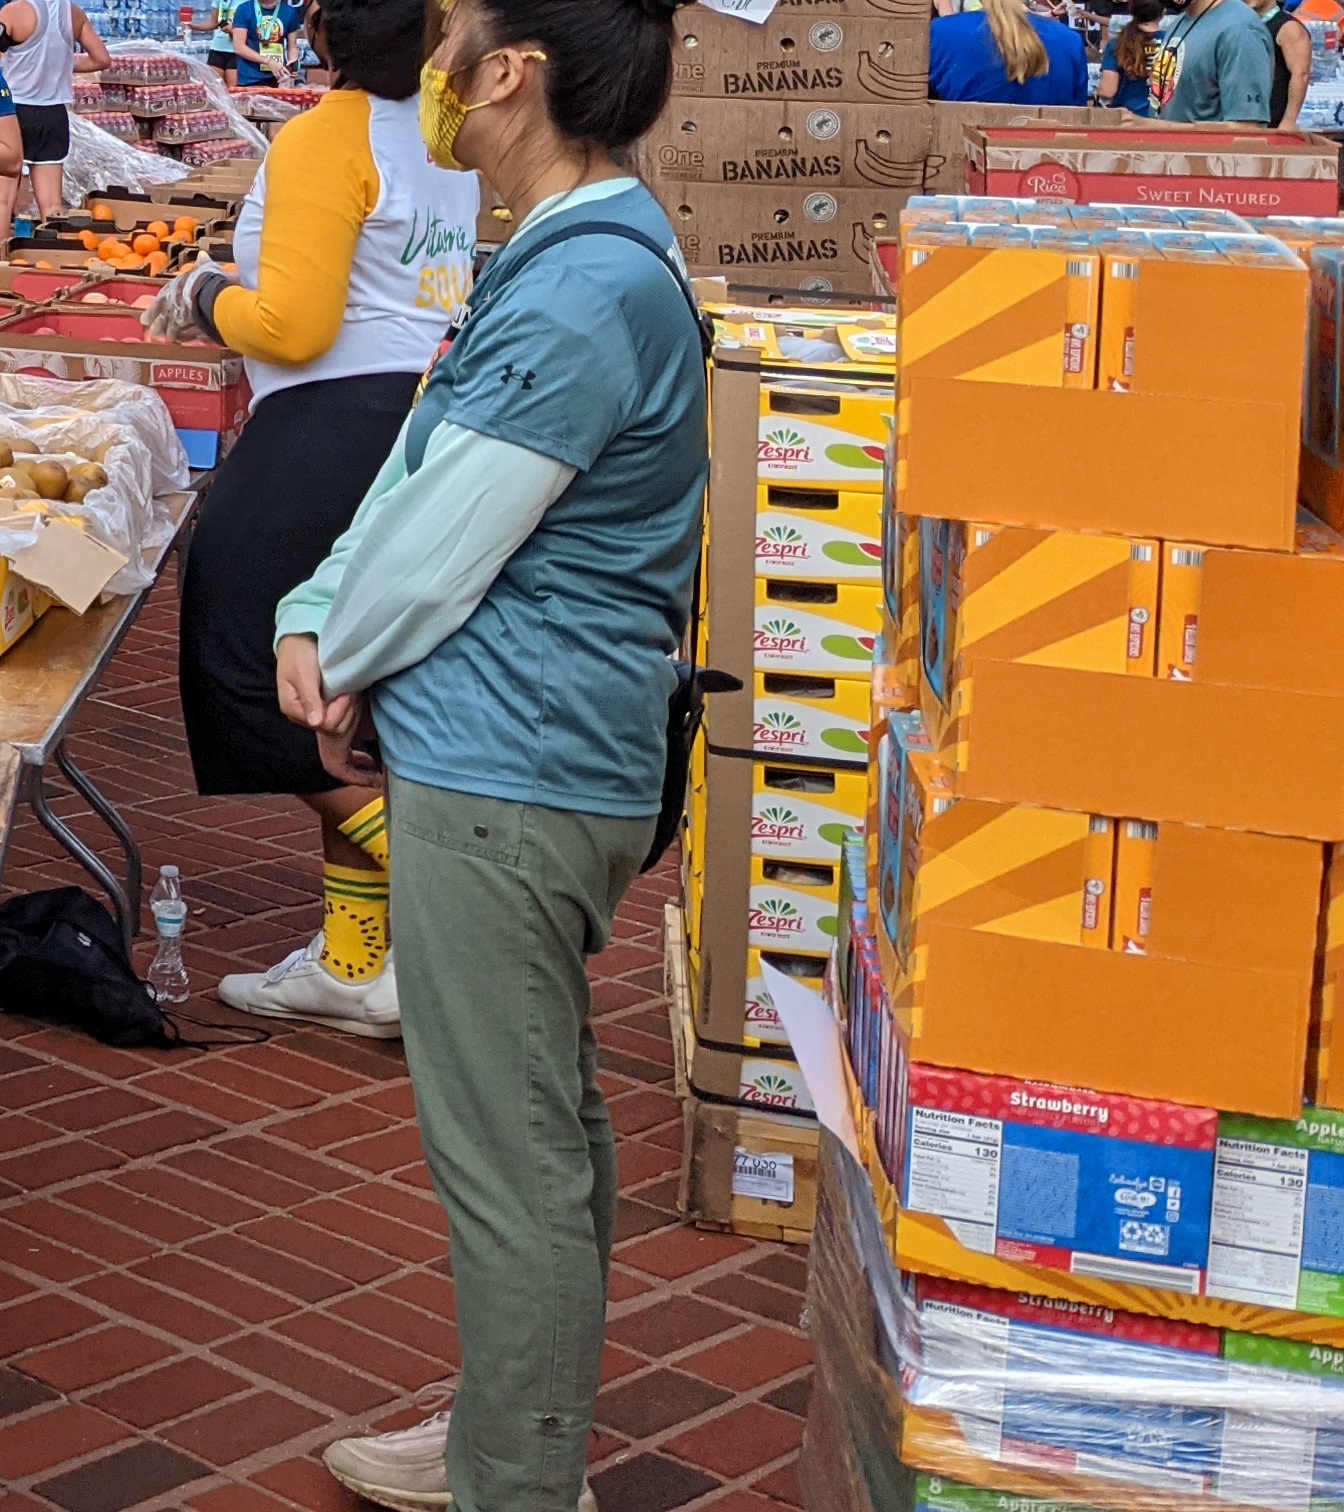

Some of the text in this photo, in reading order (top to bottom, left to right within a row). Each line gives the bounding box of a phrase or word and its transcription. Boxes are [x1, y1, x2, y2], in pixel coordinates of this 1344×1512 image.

[757, 60, 800, 70] PREMIUM
[724, 67, 843, 94] BANANAS
[659, 145, 704, 168] One
[755, 149, 798, 158] PREMIUM
[722, 156, 841, 181] BANANAS
[1027, 174, 1067, 195] Rice
[1137, 185, 1280, 205] SWEET NATURED
[678, 234, 700, 251] ne
[752, 231, 795, 241] PREMIUM
[719, 239, 837, 265] BANANAS
[158, 368, 204, 381] APPLES
[758, 441, 810, 463] Zespri
[755, 537, 807, 559] Zespri
[754, 631, 806, 653] Zespri
[753, 723, 806, 746] Zespri
[751, 817, 804, 840] Zespri
[749, 909, 802, 932] Zespri
[740, 1083, 797, 1108] Zespri
[1010, 1091, 1109, 1122] Strawberry
[915, 1109, 1000, 1131] Nutrition Facts
[1296, 1119, 1344, 1138] Apple
[914, 1138, 998, 1159] Calories 130
[1219, 1139, 1306, 1159] Nutrition Facts
[1217, 1169, 1303, 1188] Calories 130
[924, 1301, 973, 1318] Nutrition
[1017, 1292, 1114, 1324] Strawberry
